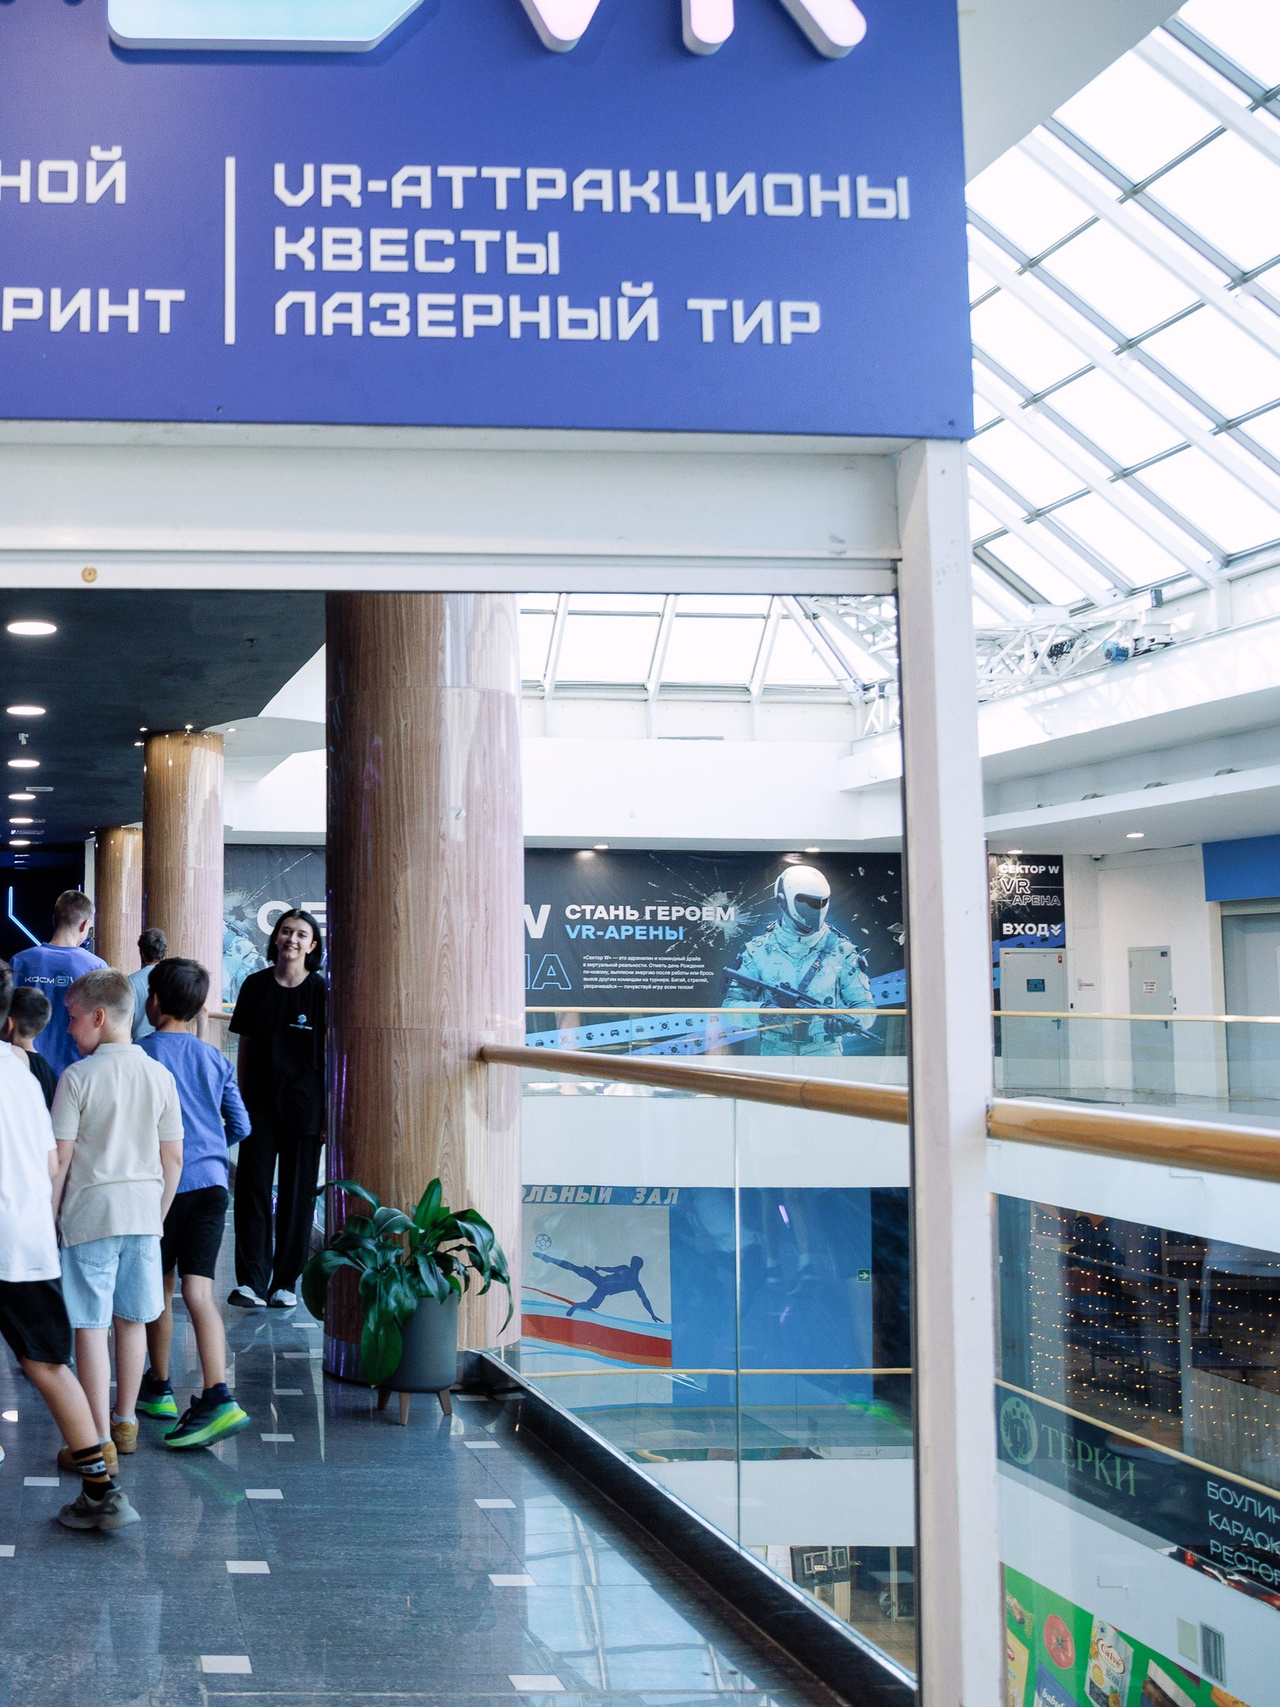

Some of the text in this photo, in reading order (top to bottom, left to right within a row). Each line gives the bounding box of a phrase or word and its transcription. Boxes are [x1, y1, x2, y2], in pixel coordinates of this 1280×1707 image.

[274, 162, 911, 222] VR-АТТРАКЦИОНЫ
[274, 226, 560, 275] КВЕСТЫ
[275, 281, 821, 345] ЛАЗЕРНЫЙ ТИР
[998, 865, 1060, 874] СЕКТОР W
[1000, 878, 1031, 894] VR
[1012, 895, 1061, 906] АРЕНА
[565, 904, 735, 921] СТАНЬ ГЕРОЕМ
[565, 924, 684, 940] VR-АРЕНЫ
[1002, 923, 1050, 937] ВХОД
[632, 1187, 680, 1205] ЗАЛ
